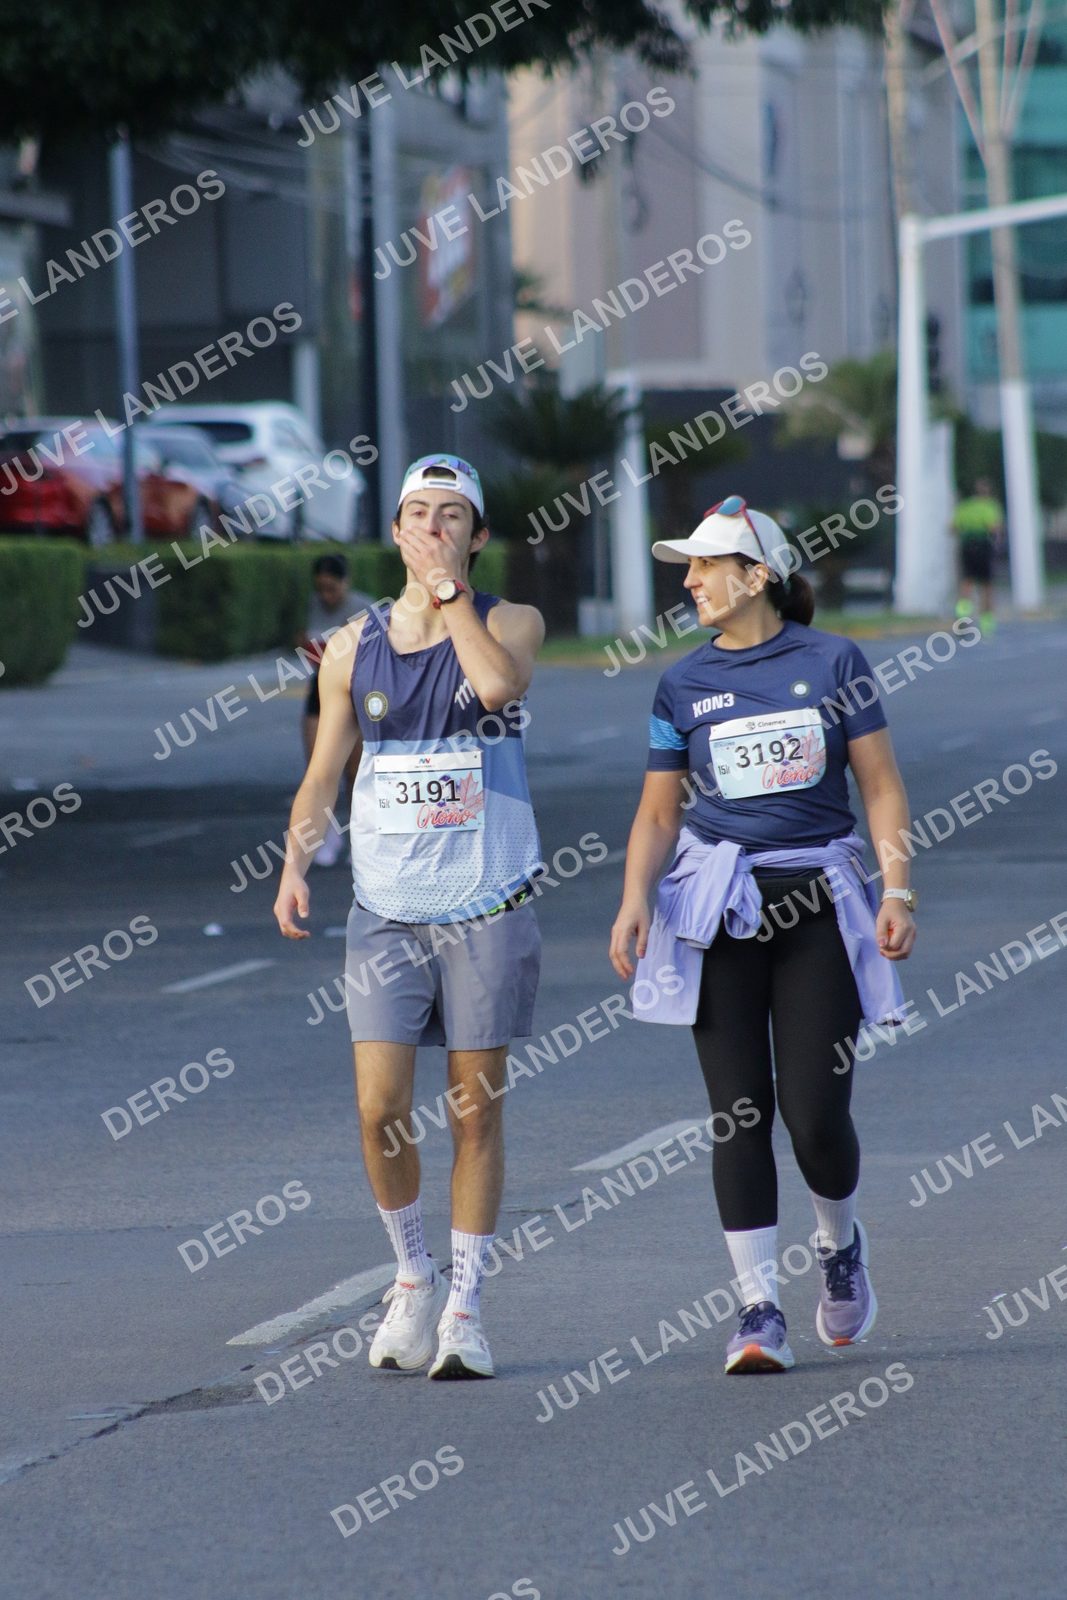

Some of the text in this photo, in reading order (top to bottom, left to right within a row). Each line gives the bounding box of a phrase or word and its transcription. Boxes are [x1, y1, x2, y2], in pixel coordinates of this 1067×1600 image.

[692, 693, 735, 718] KON3
[735, 738, 803, 768] 3192
[396, 780, 461, 804] 3191
